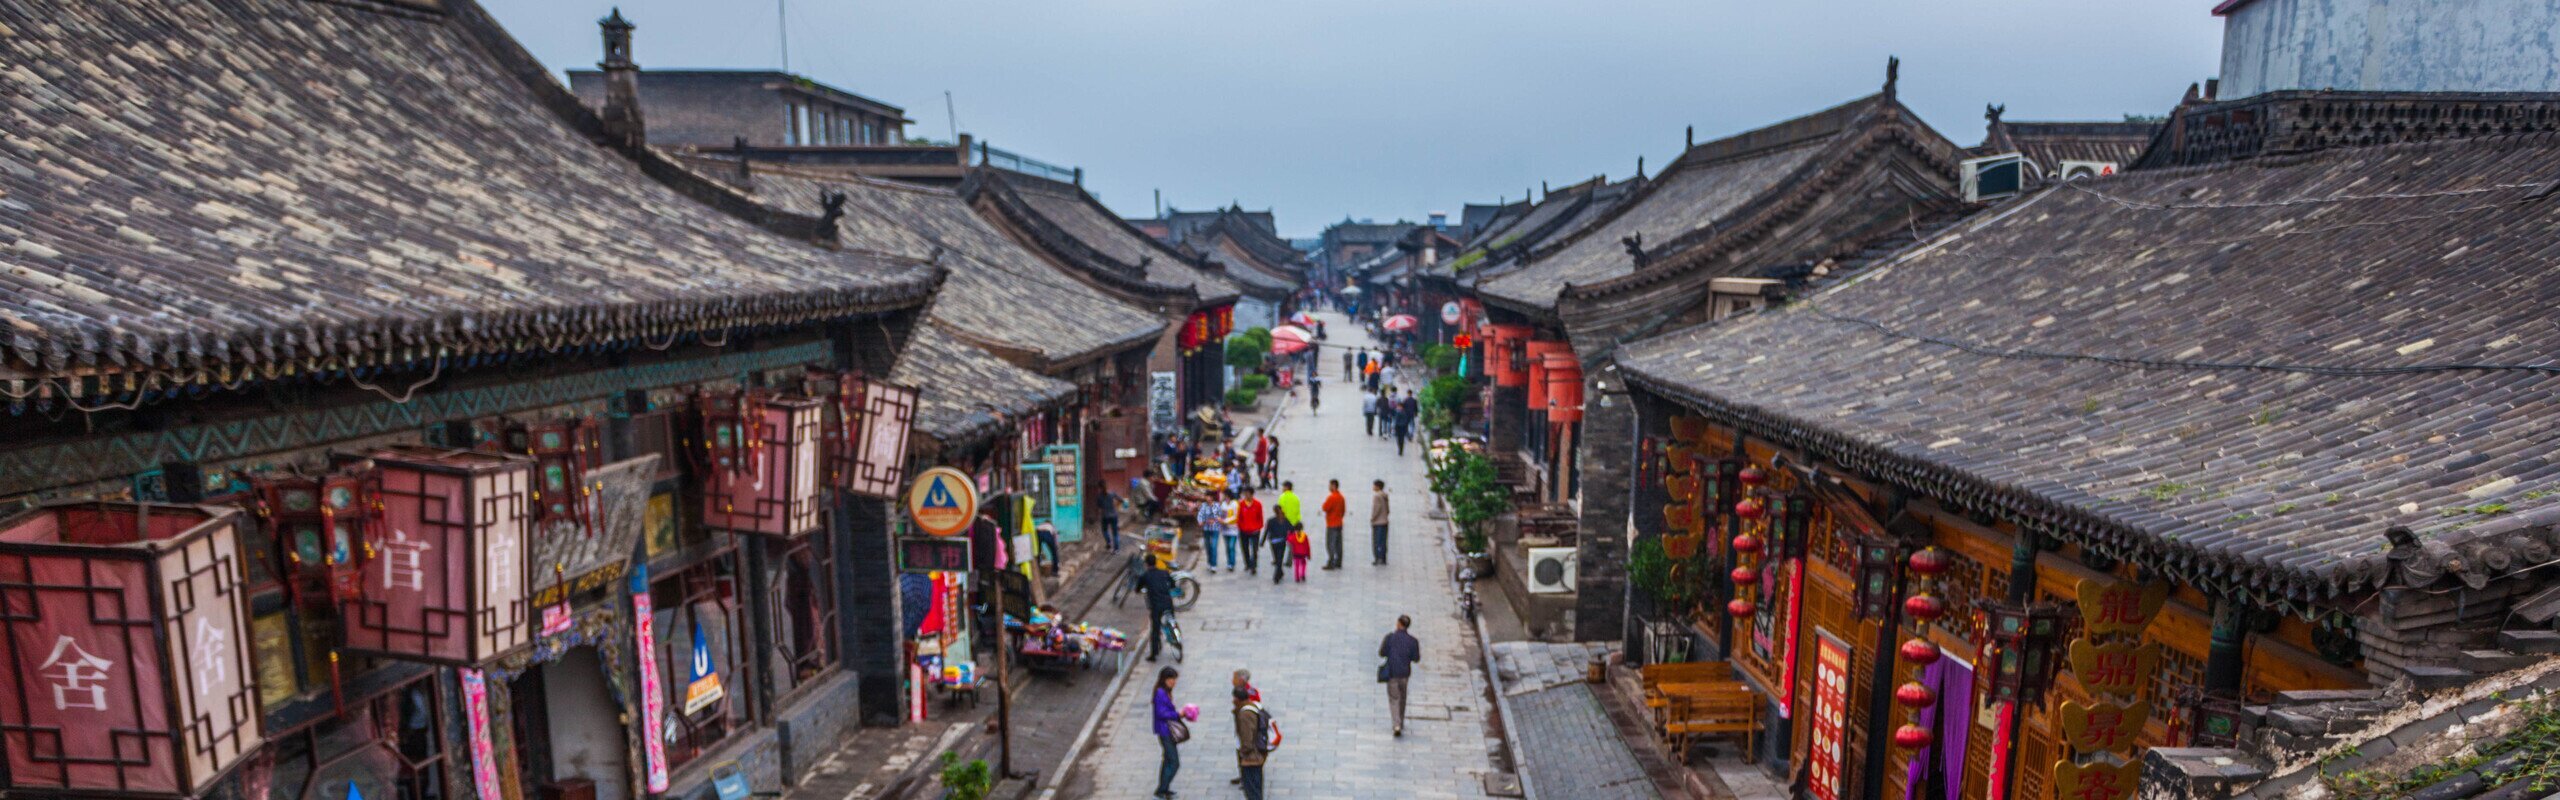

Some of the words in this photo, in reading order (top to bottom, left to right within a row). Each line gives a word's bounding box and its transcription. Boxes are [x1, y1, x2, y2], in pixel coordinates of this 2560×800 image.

[373, 528, 433, 592] 官
[489, 533, 514, 594] 官
[39, 634, 114, 711] 舍
[191, 616, 225, 696] 舍
